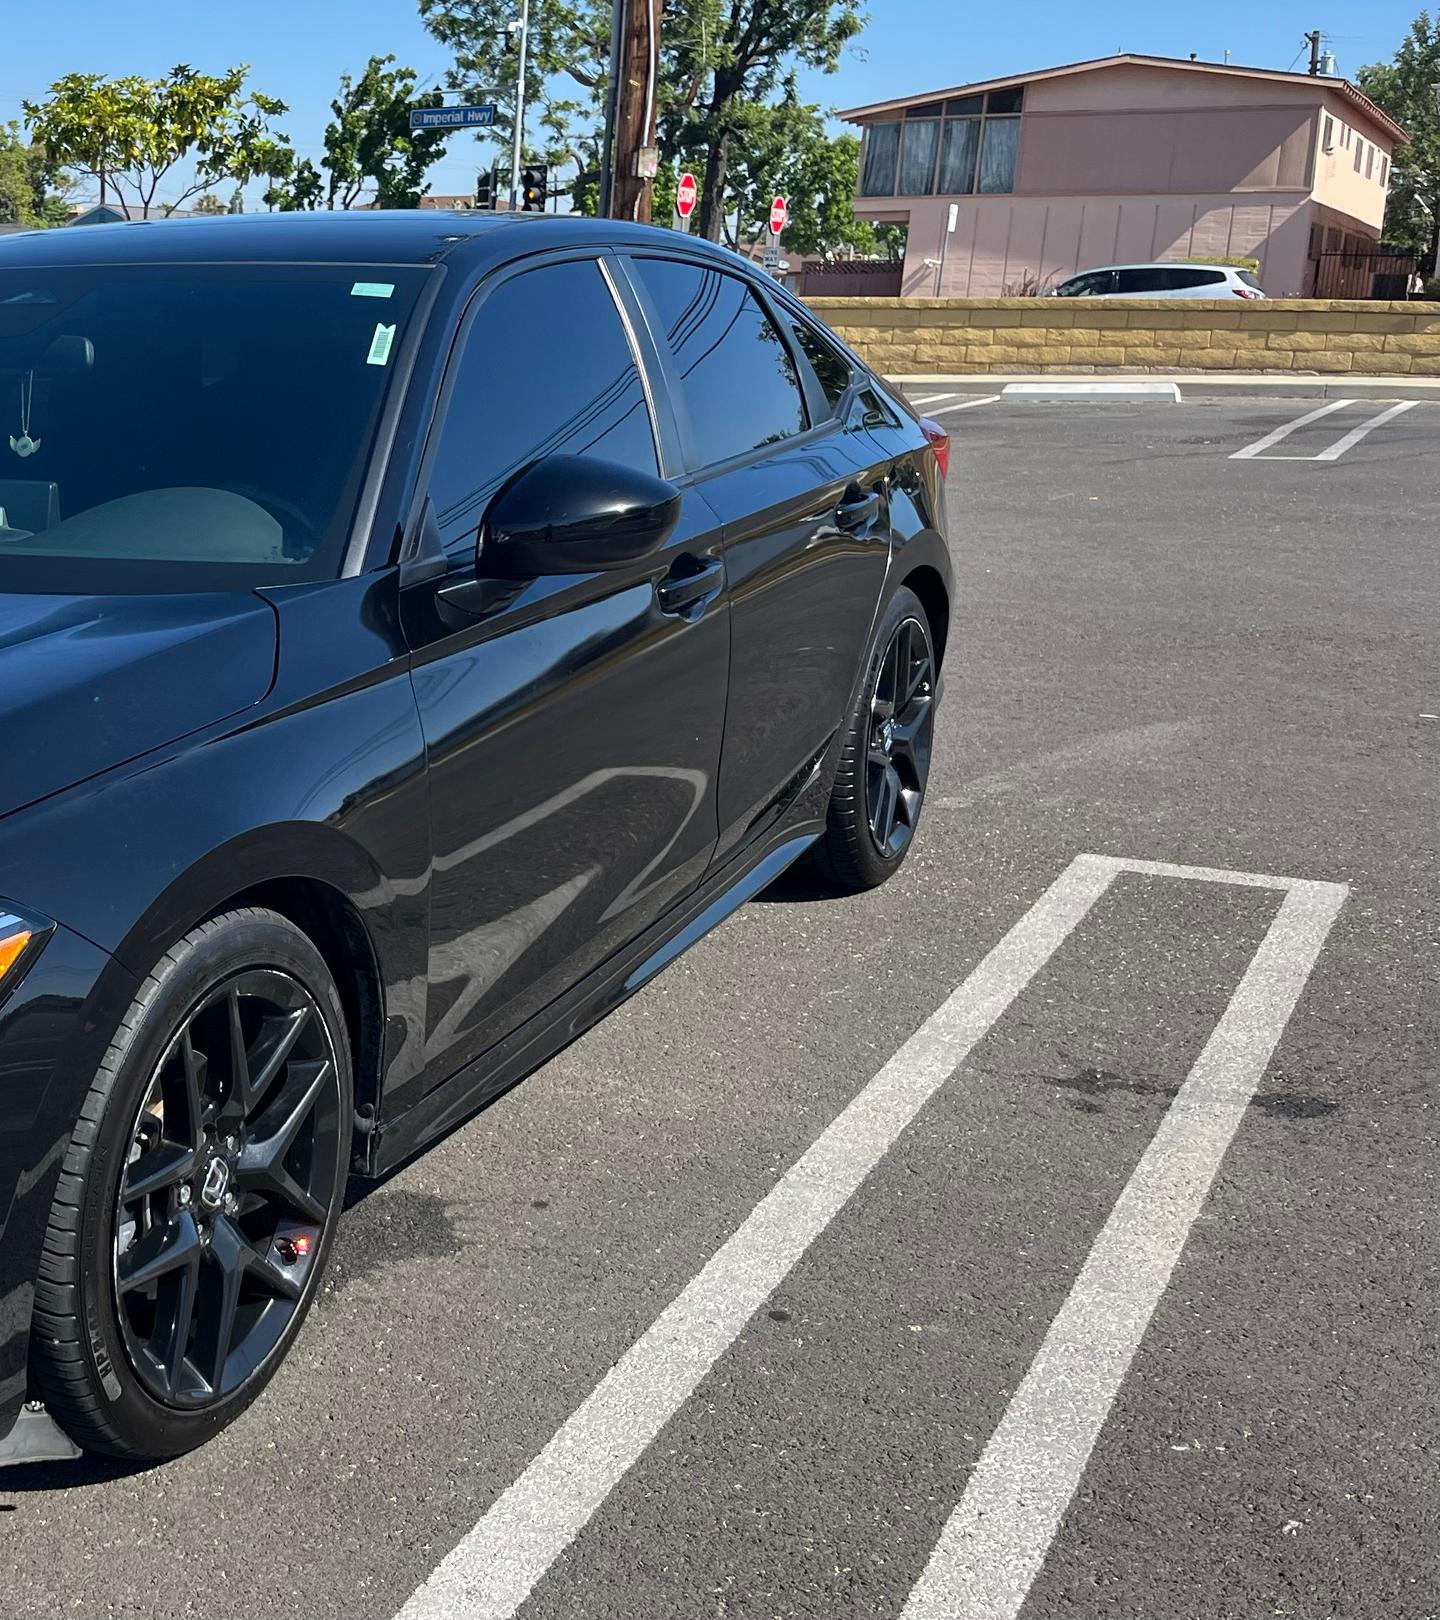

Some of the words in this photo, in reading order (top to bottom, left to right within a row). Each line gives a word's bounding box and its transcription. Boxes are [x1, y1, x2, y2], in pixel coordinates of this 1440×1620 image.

[423, 111, 464, 125] Imperial
[467, 111, 491, 124] Hwy
[679, 187, 696, 204] STOP
